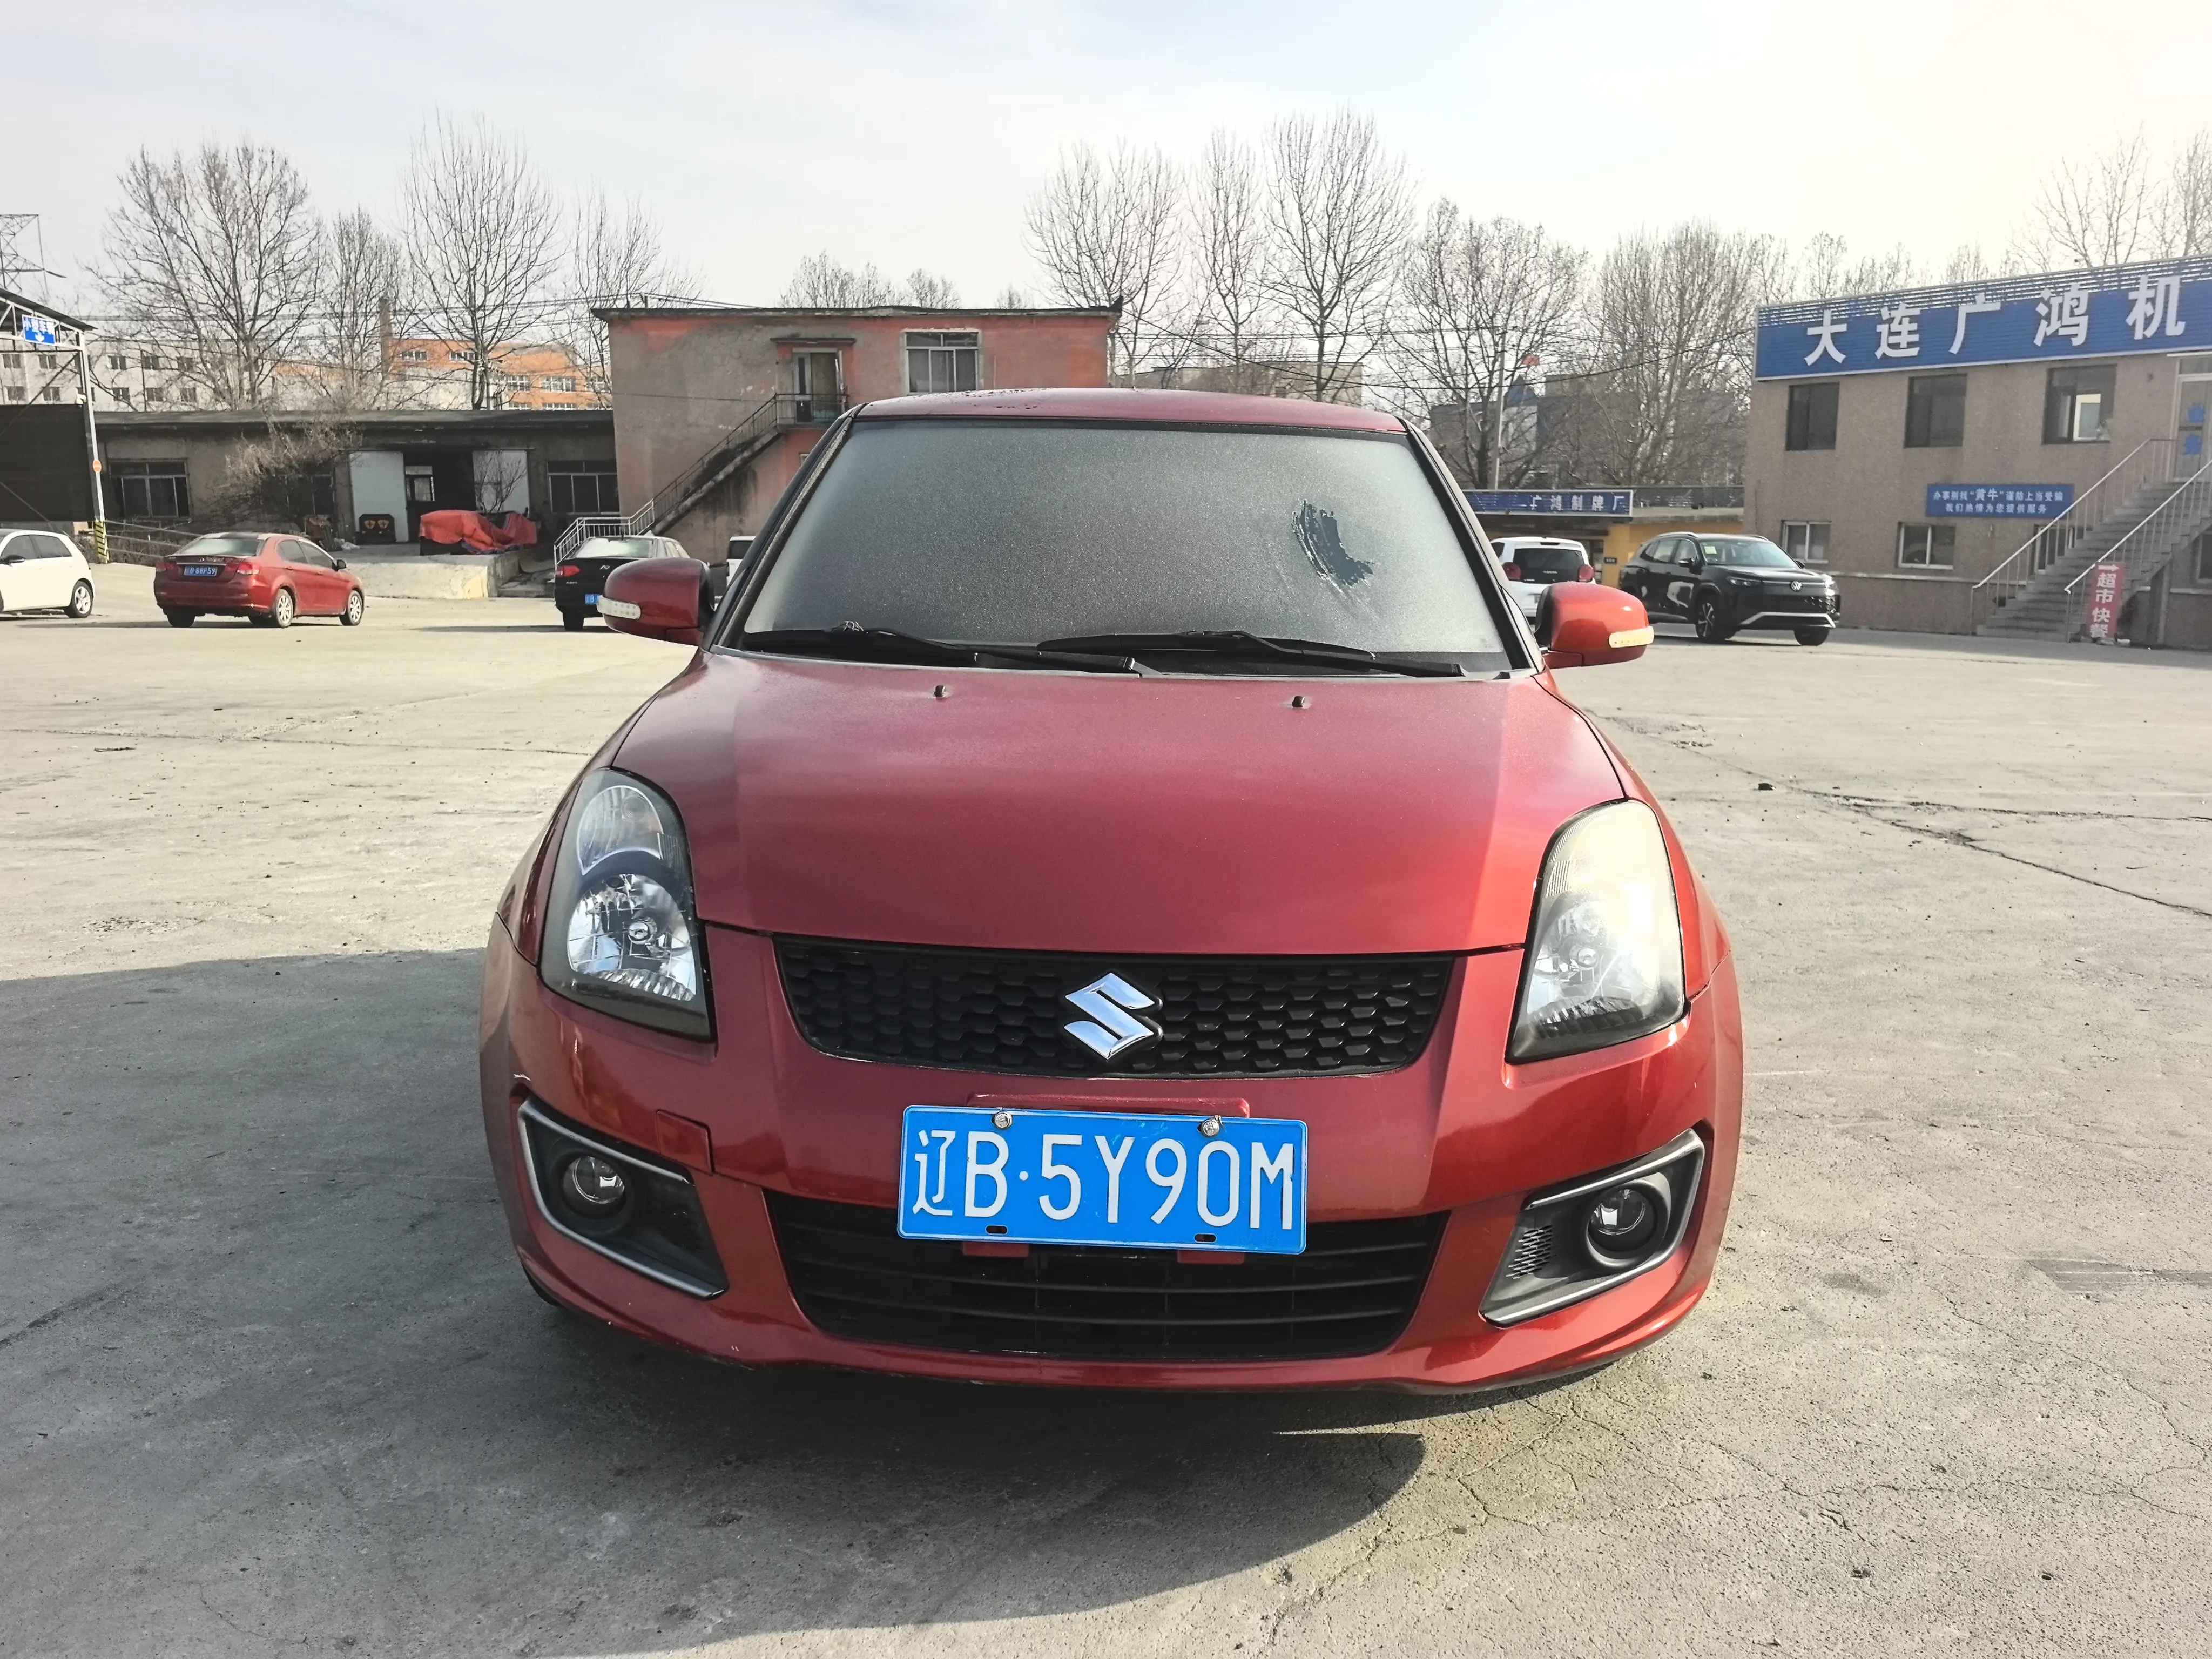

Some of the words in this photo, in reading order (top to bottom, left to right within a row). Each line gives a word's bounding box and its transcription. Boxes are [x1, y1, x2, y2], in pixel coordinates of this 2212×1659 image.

[1804, 274, 2186, 366] 大连广鸿机
[2090, 572, 2116, 638] 超市快餐
[912, 1129, 1296, 1231] 辽B·5Y90M
